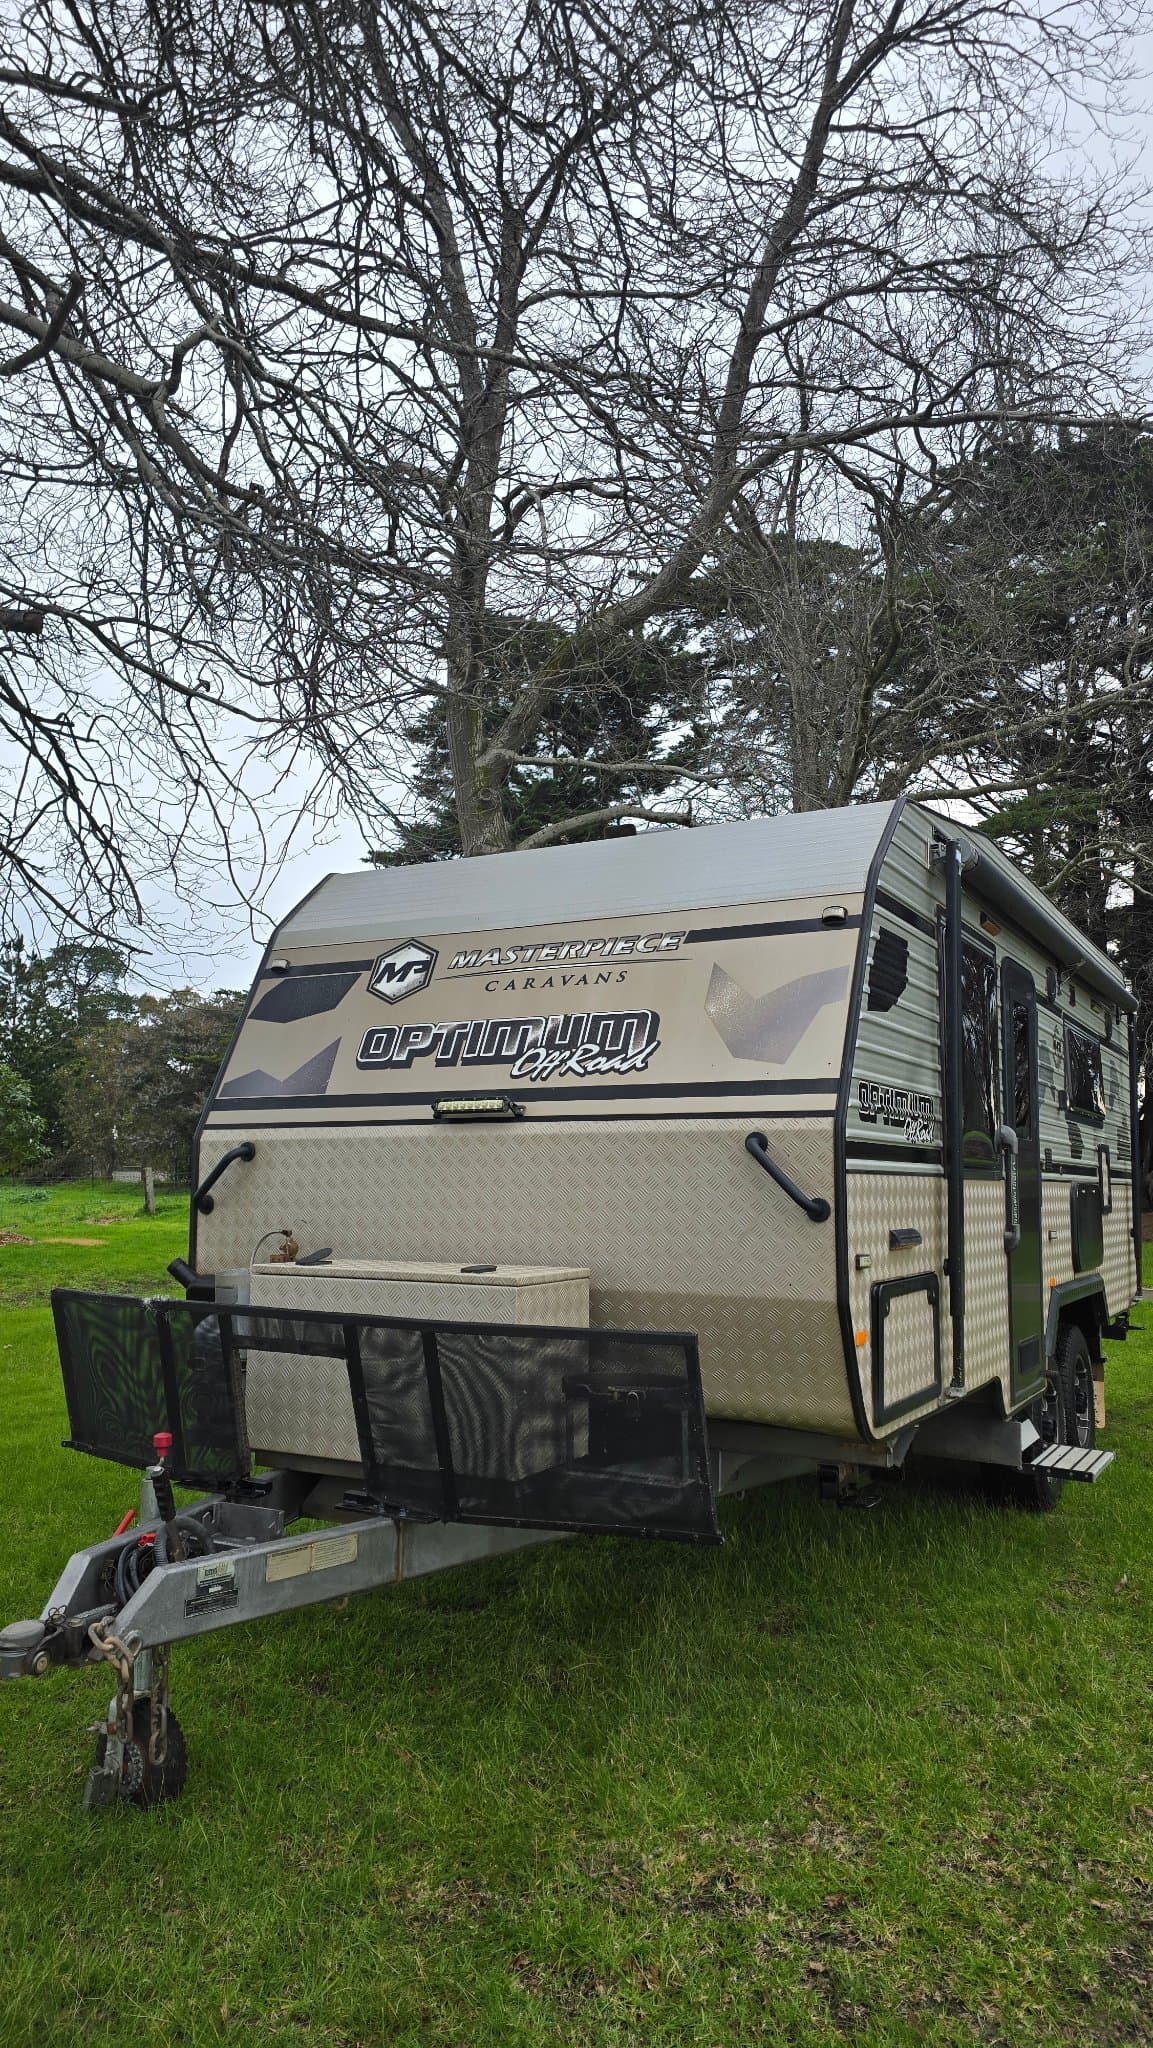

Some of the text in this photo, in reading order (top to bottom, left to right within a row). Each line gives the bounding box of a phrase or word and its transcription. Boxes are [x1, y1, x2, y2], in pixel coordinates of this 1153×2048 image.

[447, 931, 686, 970] MASTERPIECE
[485, 970, 629, 992] CARAVANS
[356, 1009, 660, 1070] OPTIMUM
[858, 1080, 935, 1128] OPTIMUM
